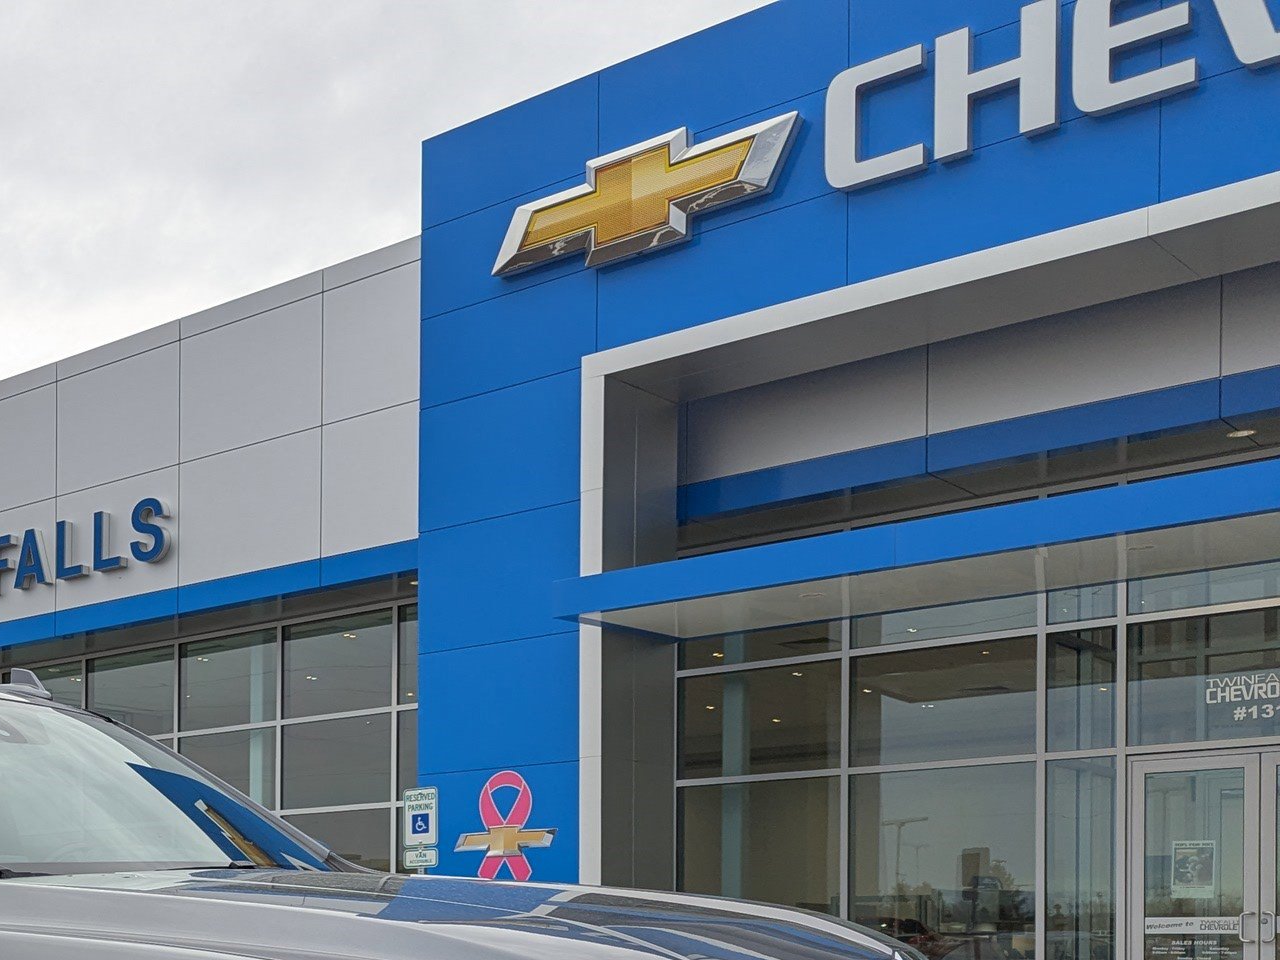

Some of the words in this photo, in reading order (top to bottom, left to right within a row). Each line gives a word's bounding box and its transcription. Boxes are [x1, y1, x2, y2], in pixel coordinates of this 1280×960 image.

[406, 792, 435, 802] RESERVED
[407, 802, 433, 812] PARKING
[1146, 922, 1183, 930] Welcome
